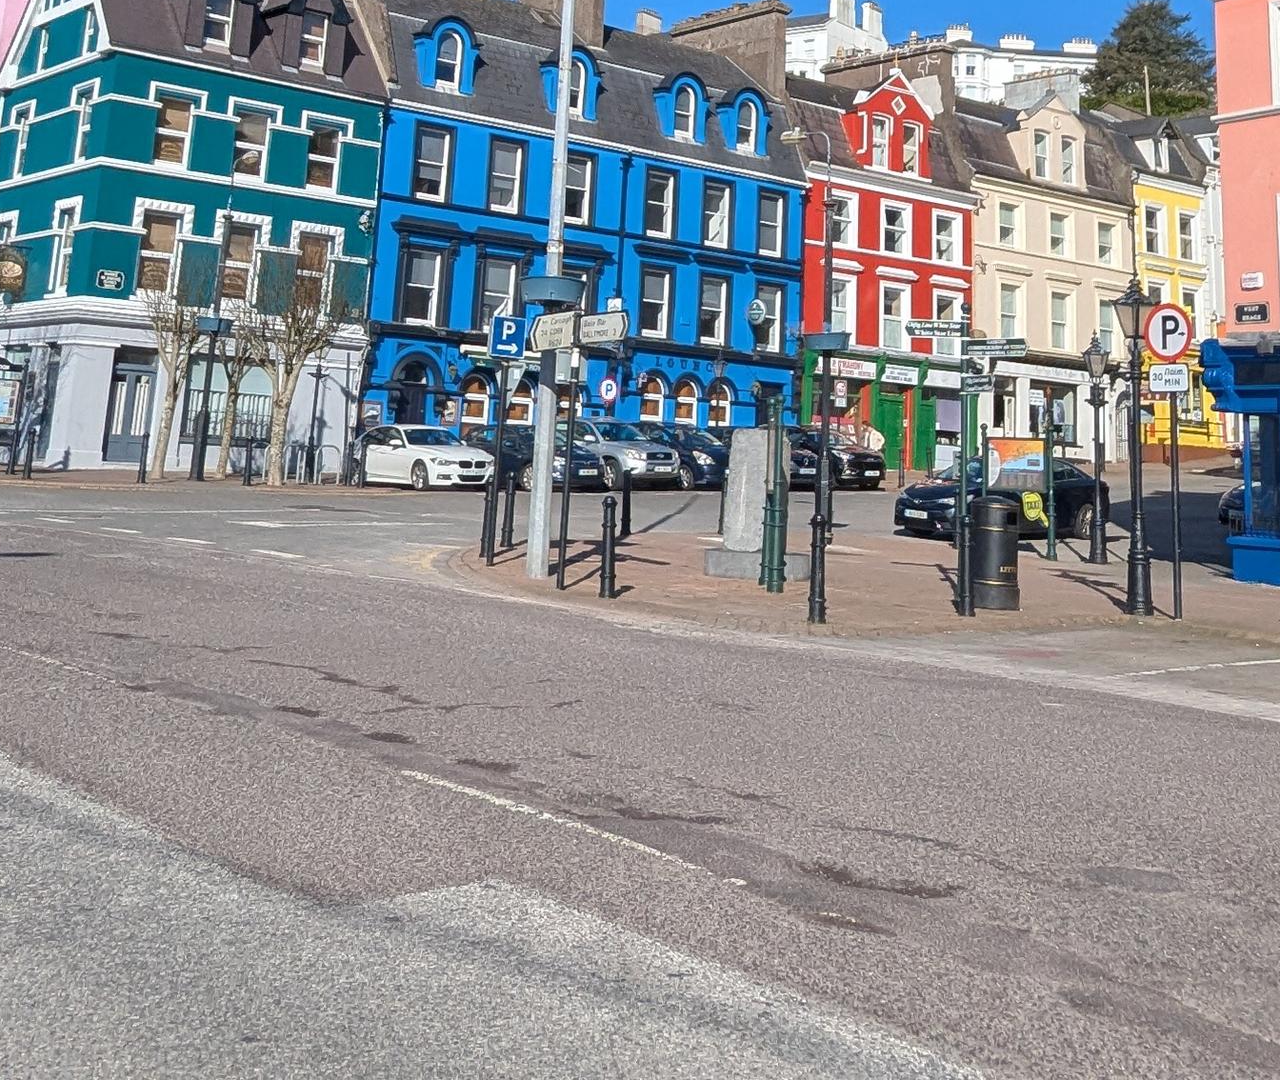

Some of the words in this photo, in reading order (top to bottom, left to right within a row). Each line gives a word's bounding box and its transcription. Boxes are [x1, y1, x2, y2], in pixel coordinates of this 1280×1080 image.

[503, 321, 516, 340] P
[1161, 315, 1179, 350] P
[1152, 372, 1163, 381] 30
[1164, 378, 1181, 386] MIN
[605, 383, 613, 395] P
